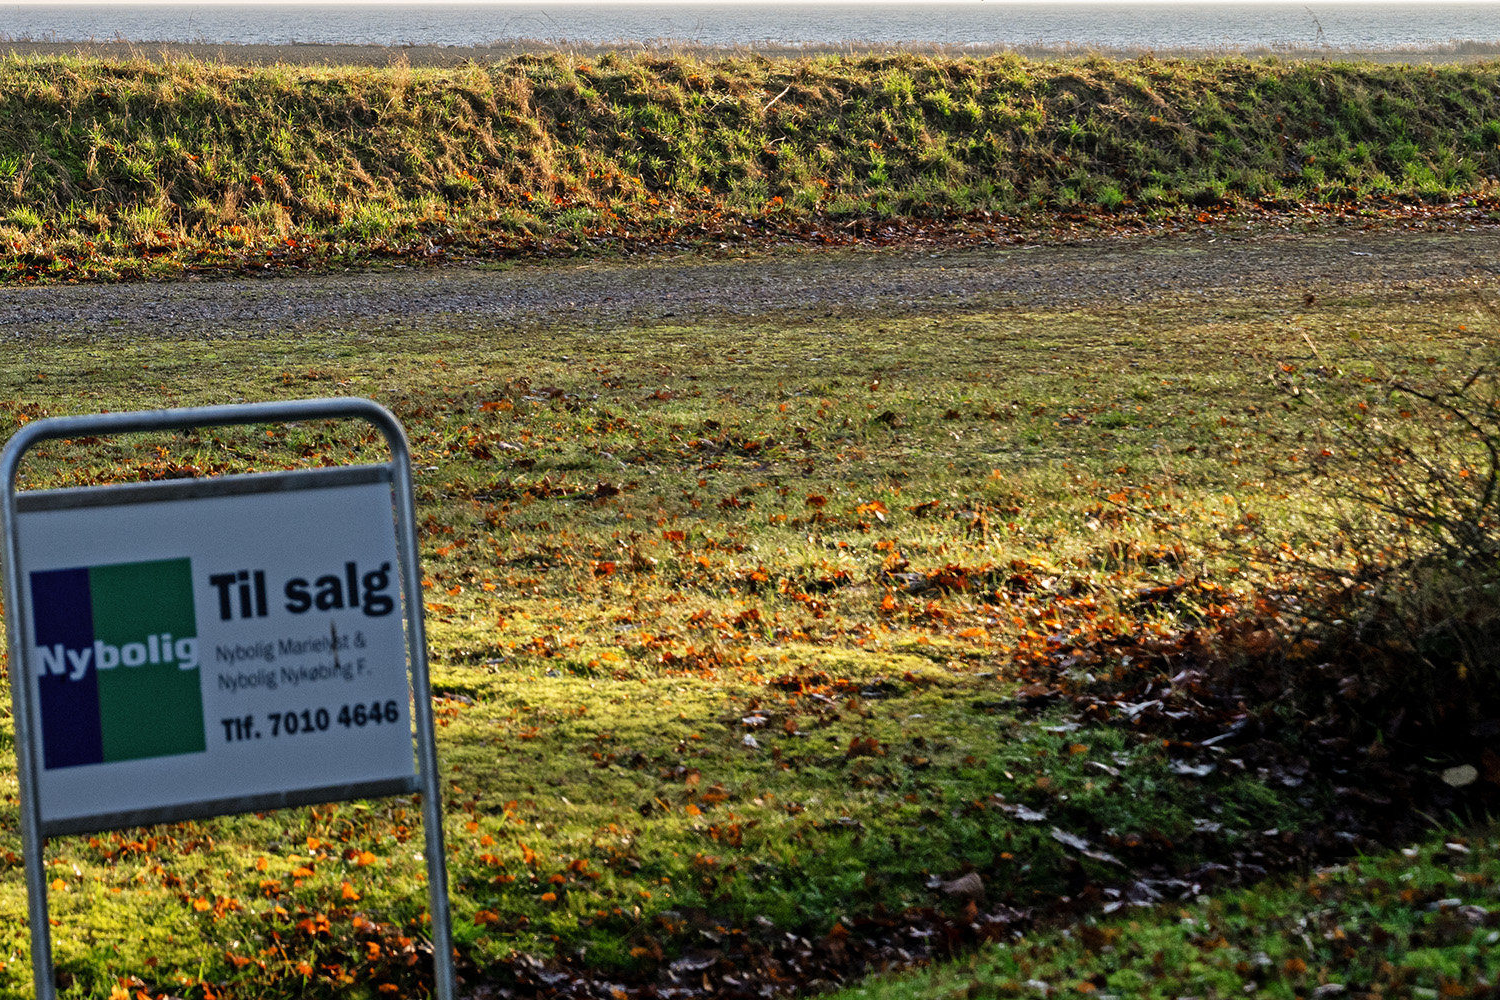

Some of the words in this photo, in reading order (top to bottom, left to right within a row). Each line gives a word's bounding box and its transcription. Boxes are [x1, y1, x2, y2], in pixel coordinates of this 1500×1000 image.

[209, 570, 268, 621] Til
[284, 561, 395, 618] salg
[35, 633, 200, 681] Nybolig
[215, 642, 276, 665] Nybolig
[353, 630, 367, 649] &
[217, 669, 277, 692] Nybolig
[280, 663, 353, 686] Nykøbing
[357, 657, 372, 676] F.
[221, 715, 261, 742] Tlf.
[268, 708, 329, 736] 7010
[337, 701, 399, 728] 4646
